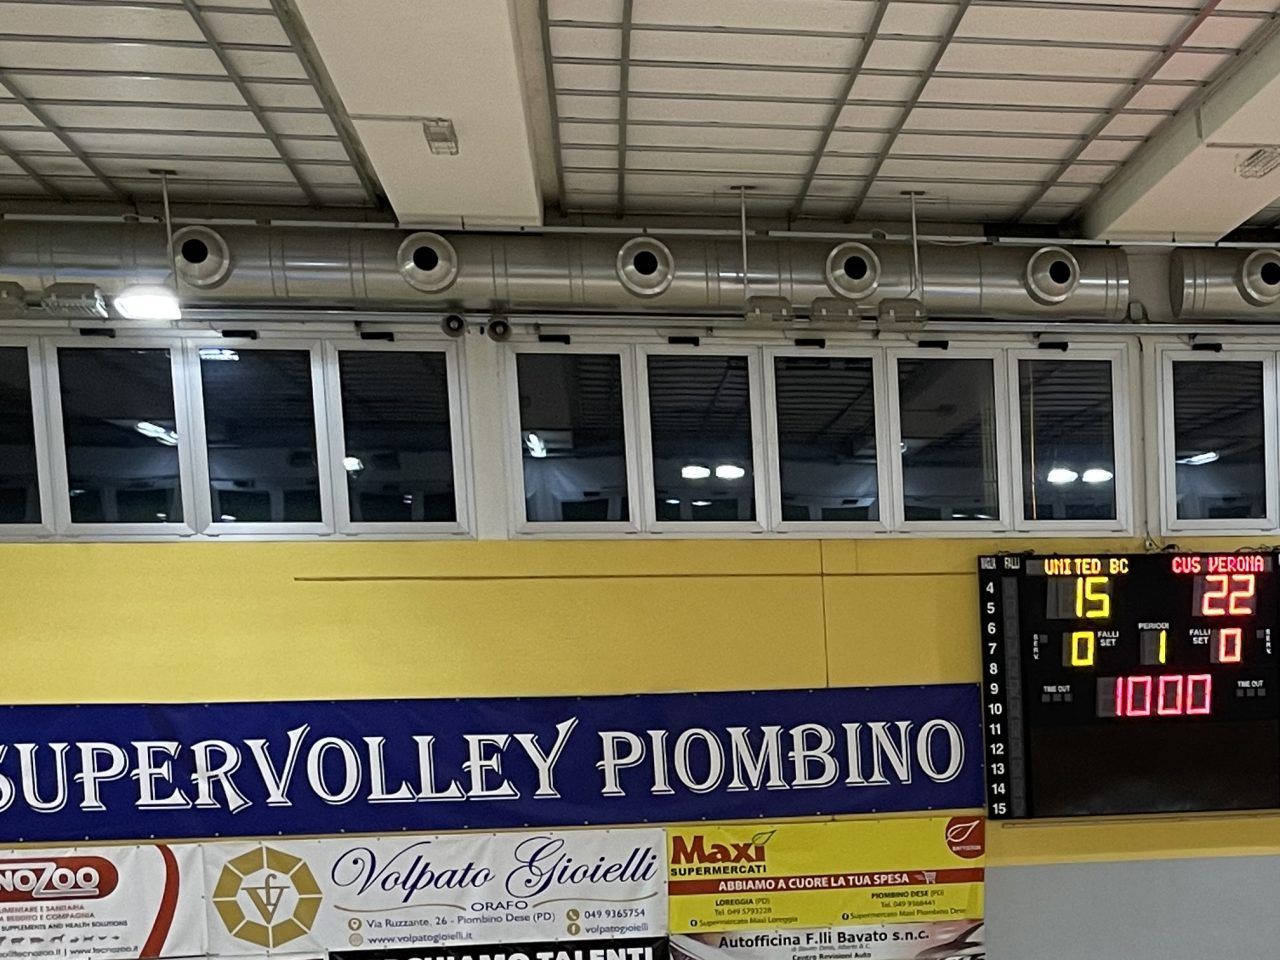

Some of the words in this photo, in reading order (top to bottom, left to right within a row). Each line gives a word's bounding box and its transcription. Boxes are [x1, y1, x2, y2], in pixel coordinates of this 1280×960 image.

[1110, 559, 1128, 573] BC
[1172, 557, 1200, 573] CUS
[1208, 557, 1264, 572] VERONA
[986, 582, 994, 593] 4
[1075, 577, 1109, 618] 15
[1202, 574, 1255, 615] 22
[987, 603, 995, 613] 5
[988, 623, 995, 634] 6
[989, 644, 996, 654] 7
[1072, 631, 1095, 666] 0
[1158, 630, 1165, 663] 1
[1219, 628, 1241, 662] 0
[990, 663, 997, 674] 8
[991, 684, 998, 694] 9
[991, 704, 1002, 715] 10
[990, 724, 1000, 734] 11
[991, 744, 1004, 754] 12
[596, 718, 965, 797] PIOMBINO
[991, 763, 1005, 774] 13
[992, 783, 1005, 794] 14
[993, 804, 1006, 814] 15
[672, 833, 766, 864] Maxi
[331, 841, 494, 902] Volpato
[506, 836, 657, 898] Gioielli
[671, 865, 766, 876] SUPERMERCATI
[718, 880, 774, 891] ABBIAMO
[777, 880, 786, 889] A
[789, 877, 829, 889] CUORE
[831, 876, 845, 887] LA
[848, 875, 871, 886] TUA
[874, 873, 909, 884] SPESA
[871, 891, 908, 899] PIOMBINO
[471, 900, 528, 911] ORAFO
[584, 910, 602, 919] 049
[605, 909, 645, 918] 9365754
[366, 919, 382, 928] Via
[436, 917, 447, 926] 26
[457, 914, 503, 925] Piombino
[506, 913, 530, 922] Dese
[533, 912, 555, 923] (PD)
[585, 923, 648, 935] volpatogioielli
[368, 931, 472, 944] www.volpatogioielli.it
[719, 935, 800, 948] Autofficina
[806, 932, 831, 944] F.lli
[838, 930, 887, 943] Bavato
[893, 930, 929, 941] s.n.c.
